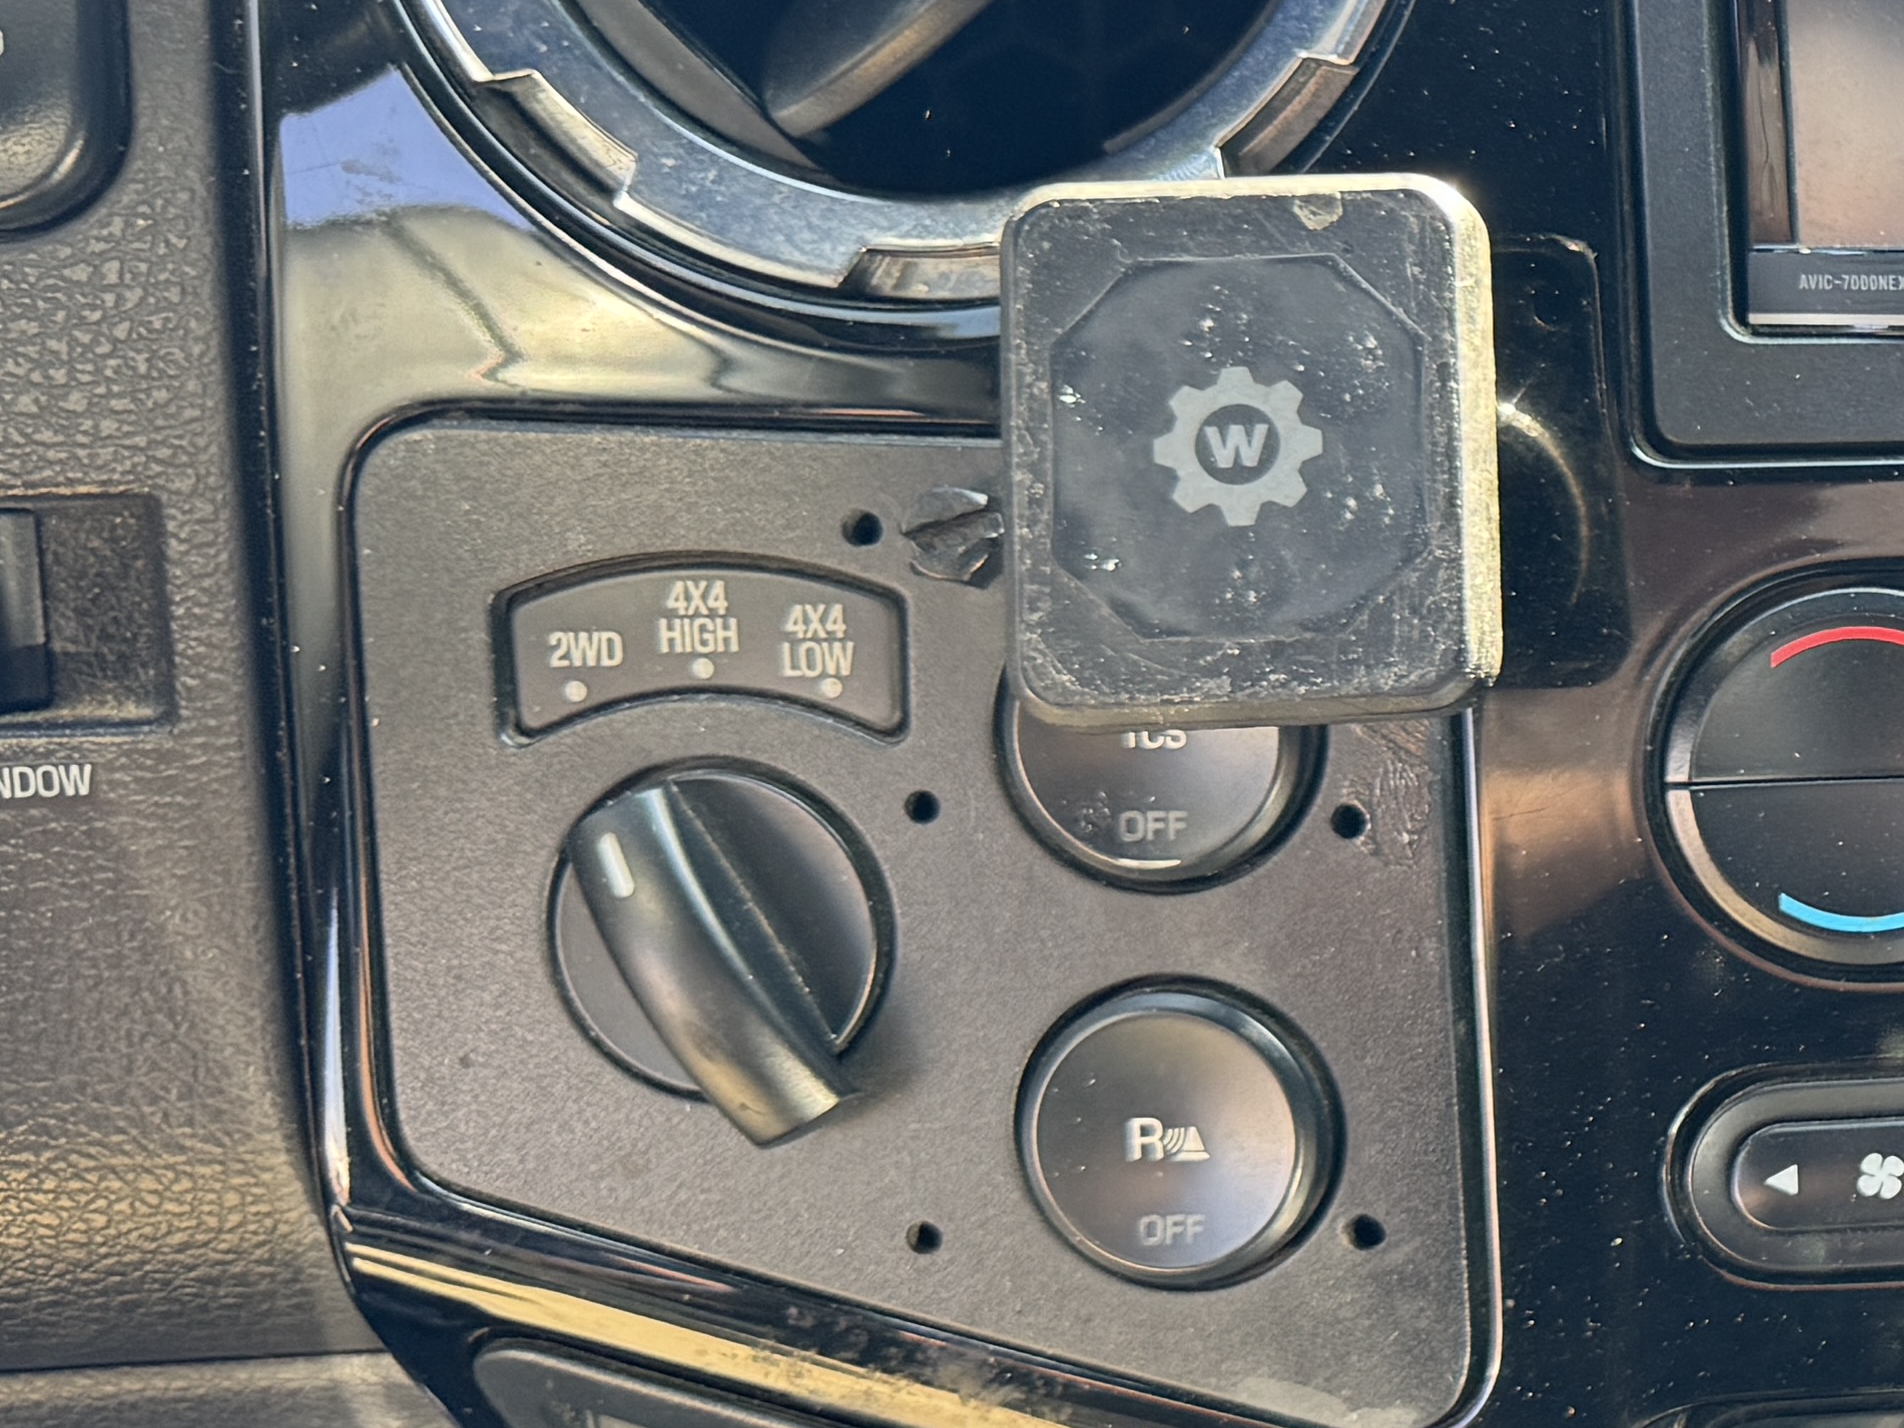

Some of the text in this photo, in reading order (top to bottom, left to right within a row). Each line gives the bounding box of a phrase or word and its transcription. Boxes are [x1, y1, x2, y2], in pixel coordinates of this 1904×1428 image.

[1204, 424, 1269, 468] W
[666, 579, 729, 616] 4X4
[658, 617, 740, 655] HIGH
[784, 603, 847, 640] 4X4
[549, 631, 624, 668] 2WD
[781, 641, 855, 678] LOW
[1119, 810, 1188, 842] OFF
[1138, 1213, 1206, 1246] OFF
